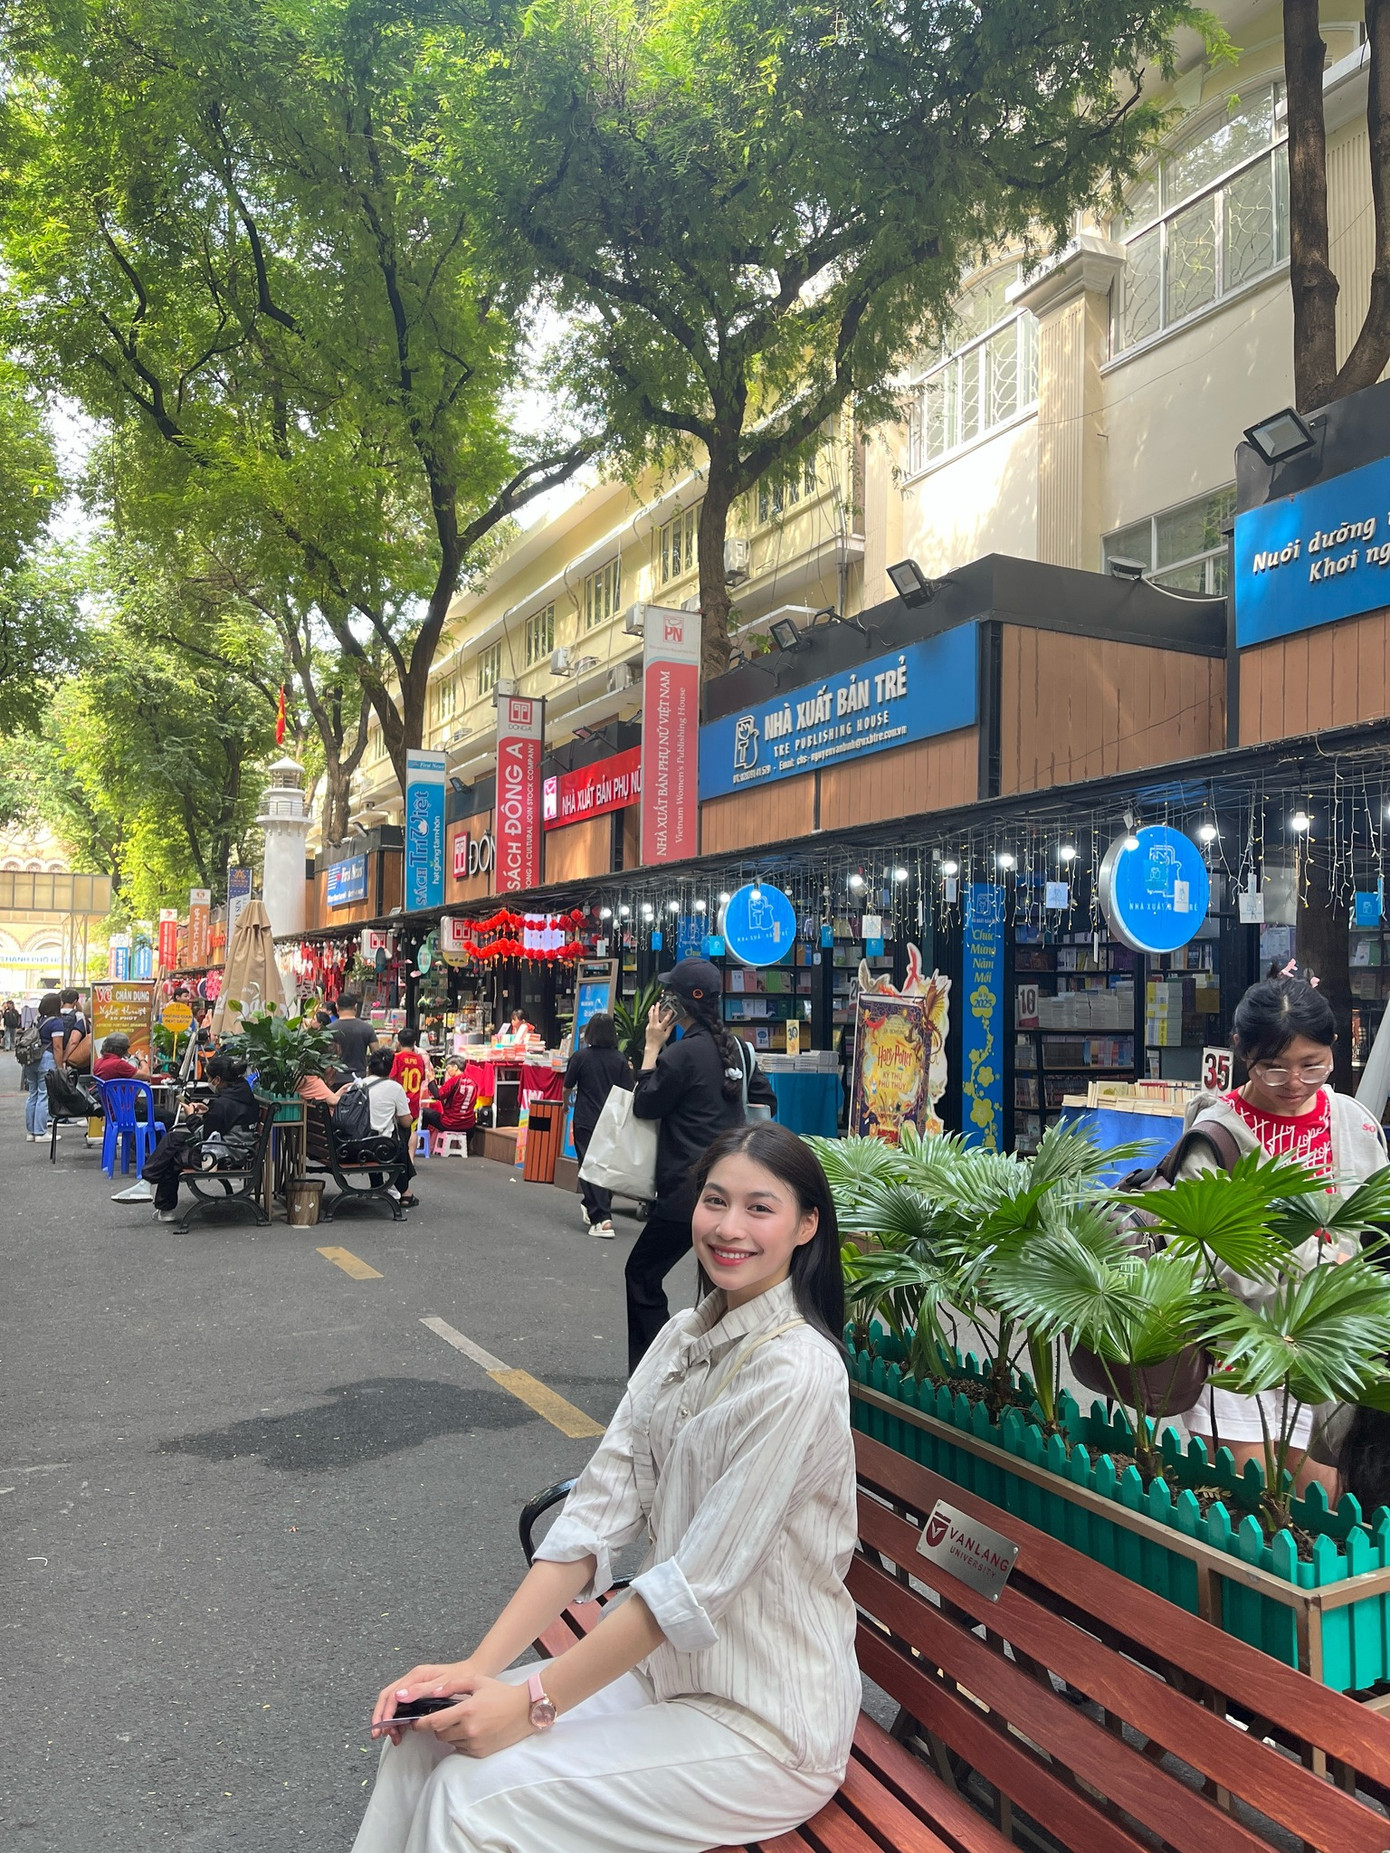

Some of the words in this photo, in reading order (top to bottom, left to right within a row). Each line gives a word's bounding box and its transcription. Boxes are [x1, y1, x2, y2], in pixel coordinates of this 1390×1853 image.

[1252, 539, 1301, 573] Nuôi
[1308, 517, 1376, 553] dưỡng
[1309, 549, 1359, 582] Khơi
[660, 670, 670, 699] NAM
[764, 703, 793, 741] NHÀ
[796, 685, 833, 730] XUẤT
[837, 674, 869, 717] BẢN
[874, 655, 908, 703] TRẺ
[657, 699, 671, 724] VIỆT
[678, 687, 686, 716] House
[677, 718, 688, 764] Publishing
[774, 742, 790, 758] TRE
[795, 722, 852, 751] PUBLISHING
[857, 710, 889, 732] HOUSE
[506, 742, 523, 760] A
[658, 745, 670, 771] PHỤ
[562, 788, 576, 817] NHÀ
[577, 778, 595, 812] XUẤT
[596, 774, 612, 806] BẢN
[613, 773, 629, 801] PHỤ
[656, 771, 668, 796] BẢN
[676, 765, 685, 805] Women's
[500, 764, 523, 836] ĐÔNG
[654, 797, 668, 828] XUẤT
[676, 807, 684, 843] Vietnam
[655, 830, 668, 856] NHÀ
[503, 842, 522, 890] SÁCH
[413, 868, 428, 906] SÁCH
[972, 958, 994, 969] Năm
[974, 972, 992, 983] Mới
[401, 1067, 422, 1094] 10
[1204, 1053, 1230, 1090] 35
[460, 1084, 475, 1114] 7
[950, 1527, 1010, 1572] VANLANG
[950, 1546, 996, 1578] UNIVERSITY
